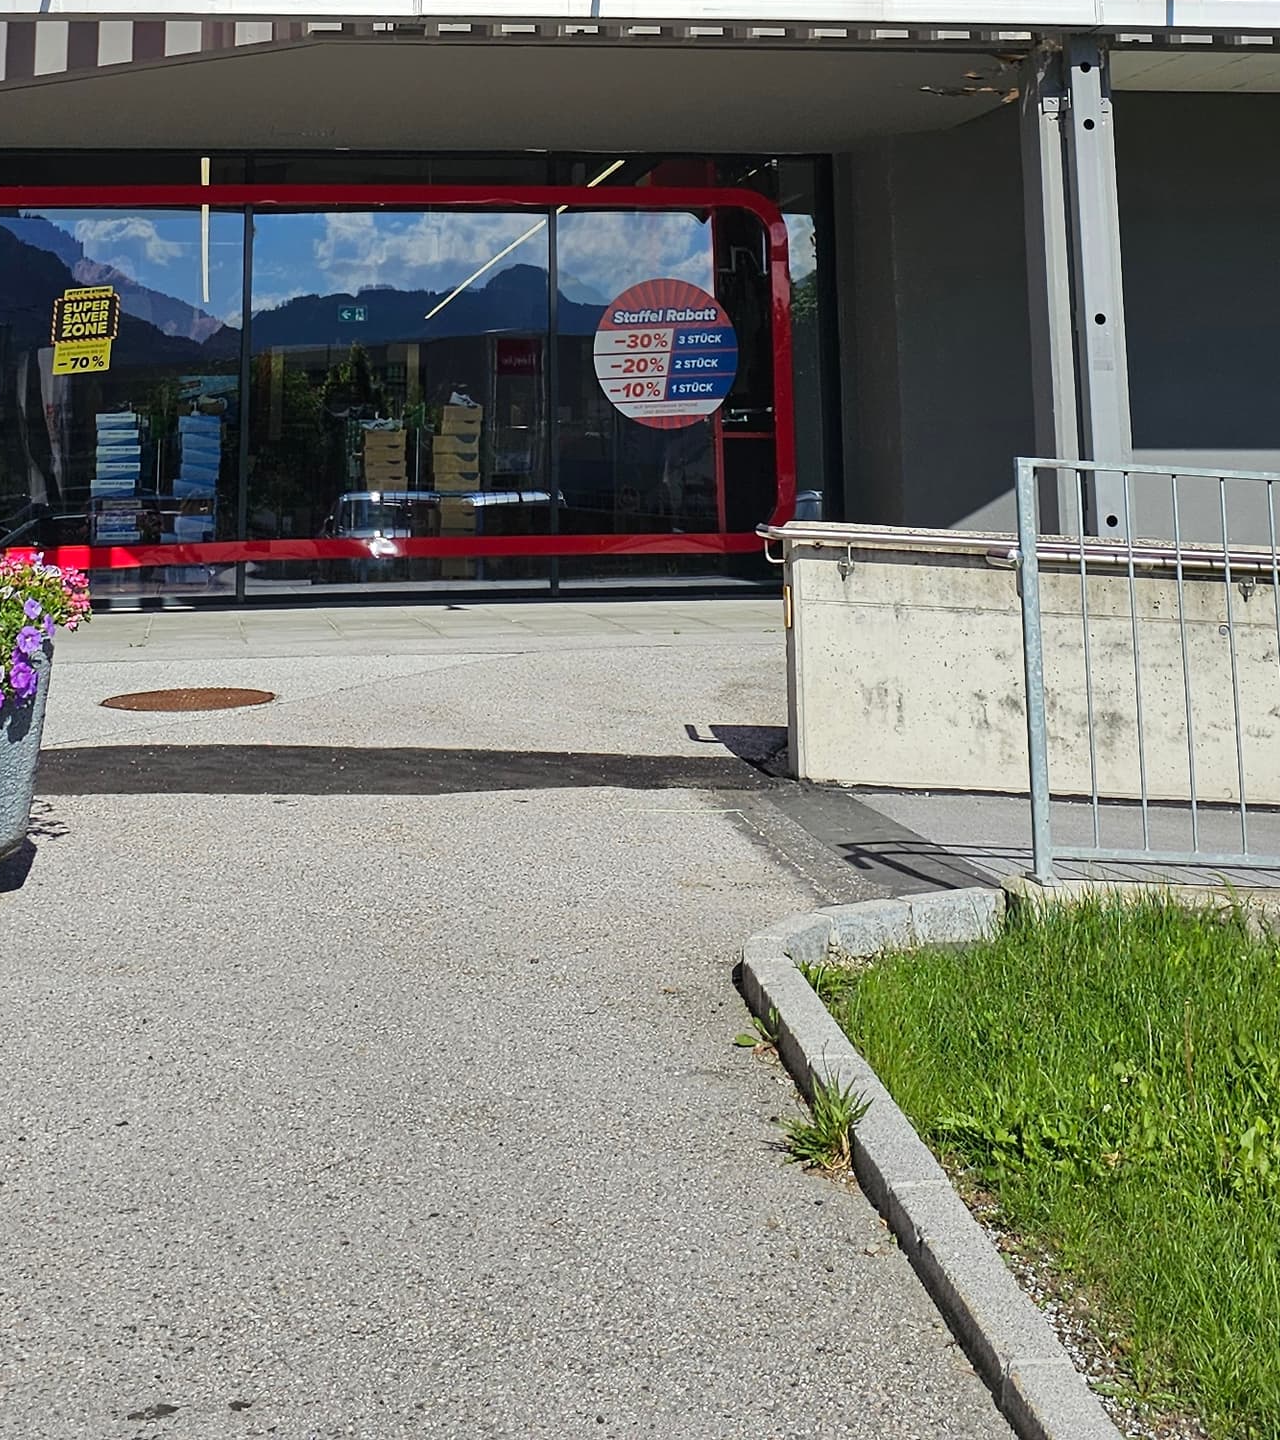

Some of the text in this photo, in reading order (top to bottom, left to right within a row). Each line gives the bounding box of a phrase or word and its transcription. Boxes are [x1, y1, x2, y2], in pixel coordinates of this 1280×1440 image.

[63, 300, 110, 313] SUPER
[62, 310, 109, 324] SAVER
[613, 308, 717, 323] Staffel Rabatt
[61, 321, 108, 337] ZONE
[614, 333, 723, 349] -30% 3 STÜCK
[610, 357, 719, 374] -20% 2 STÜCK
[609, 381, 714, 398] -10% 1 STÜCK
